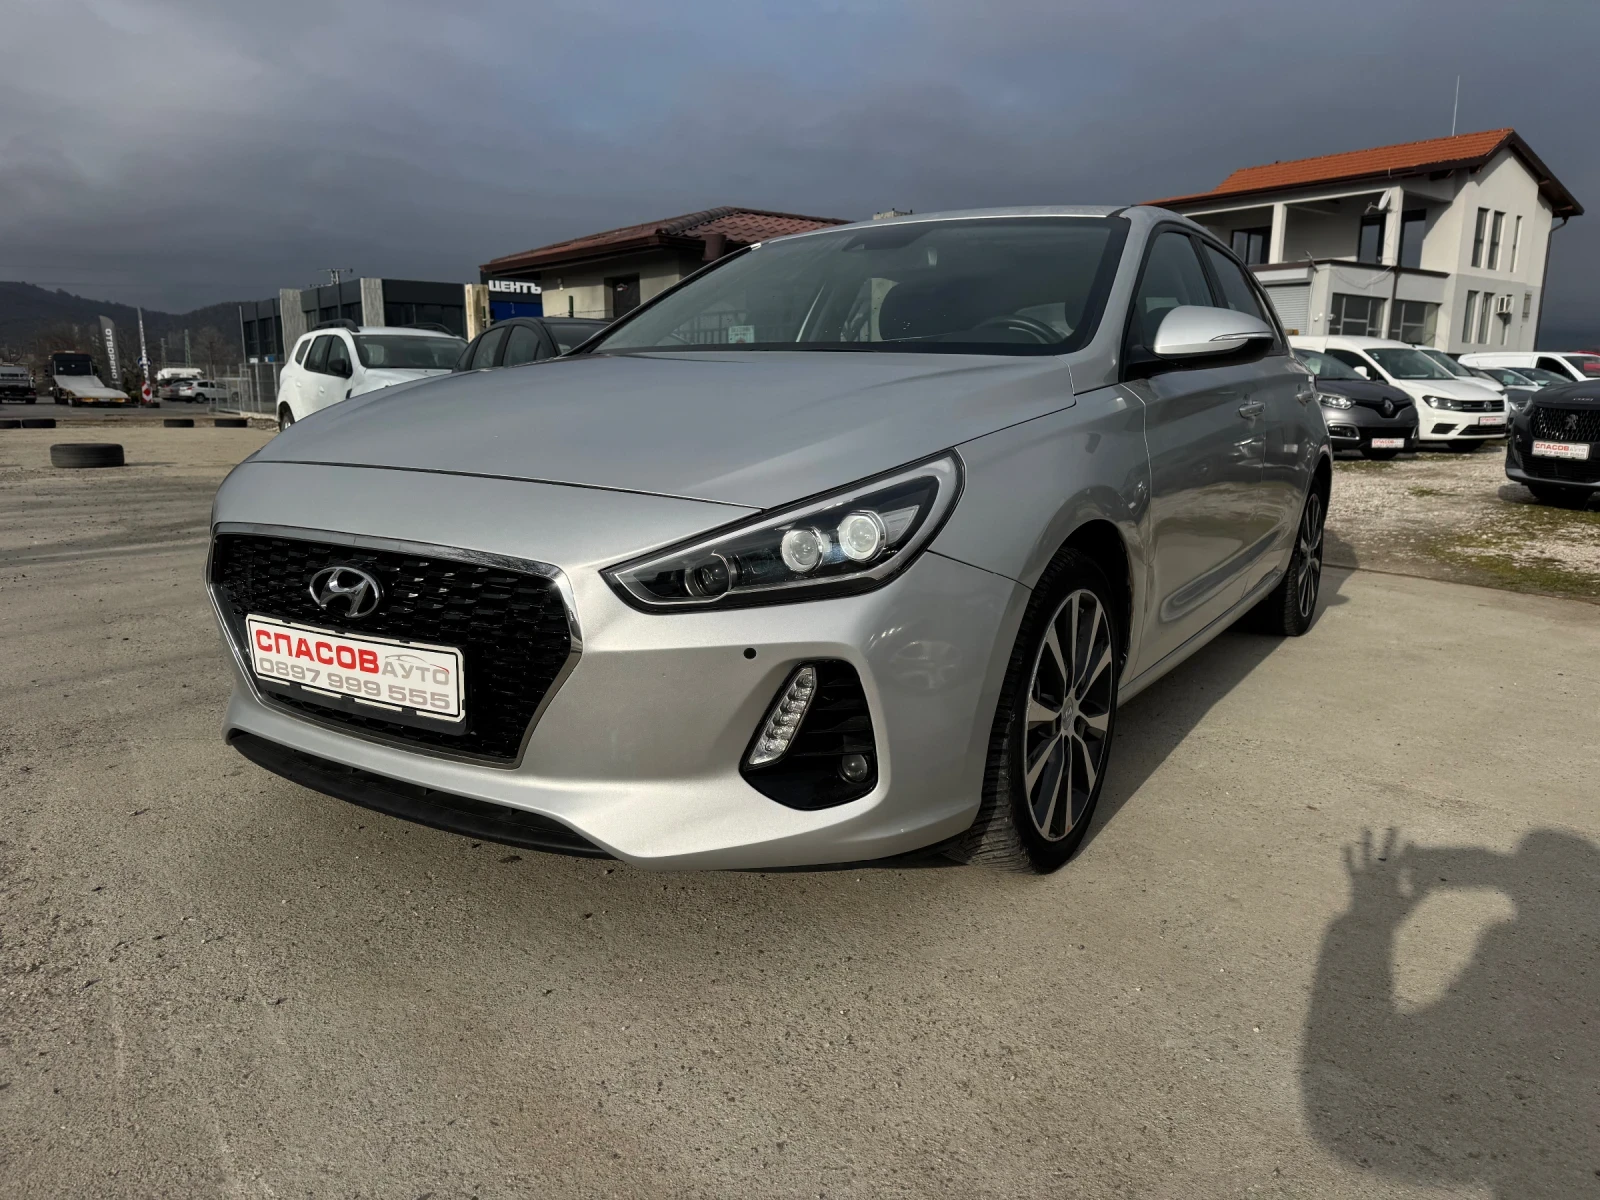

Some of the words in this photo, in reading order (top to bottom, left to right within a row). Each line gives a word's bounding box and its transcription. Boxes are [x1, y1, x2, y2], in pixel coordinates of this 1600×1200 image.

[488, 279, 542, 295] ЦЕНТЪ
[105, 328, 118, 379] ОТВОРЕНО
[1535, 443, 1569, 451] СПАСОВ
[255, 629, 380, 674] СПАСОВ
[381, 661, 450, 686] АУТО
[259, 657, 321, 683] 0897
[327, 672, 381, 697] 999
[388, 684, 450, 710] 555
